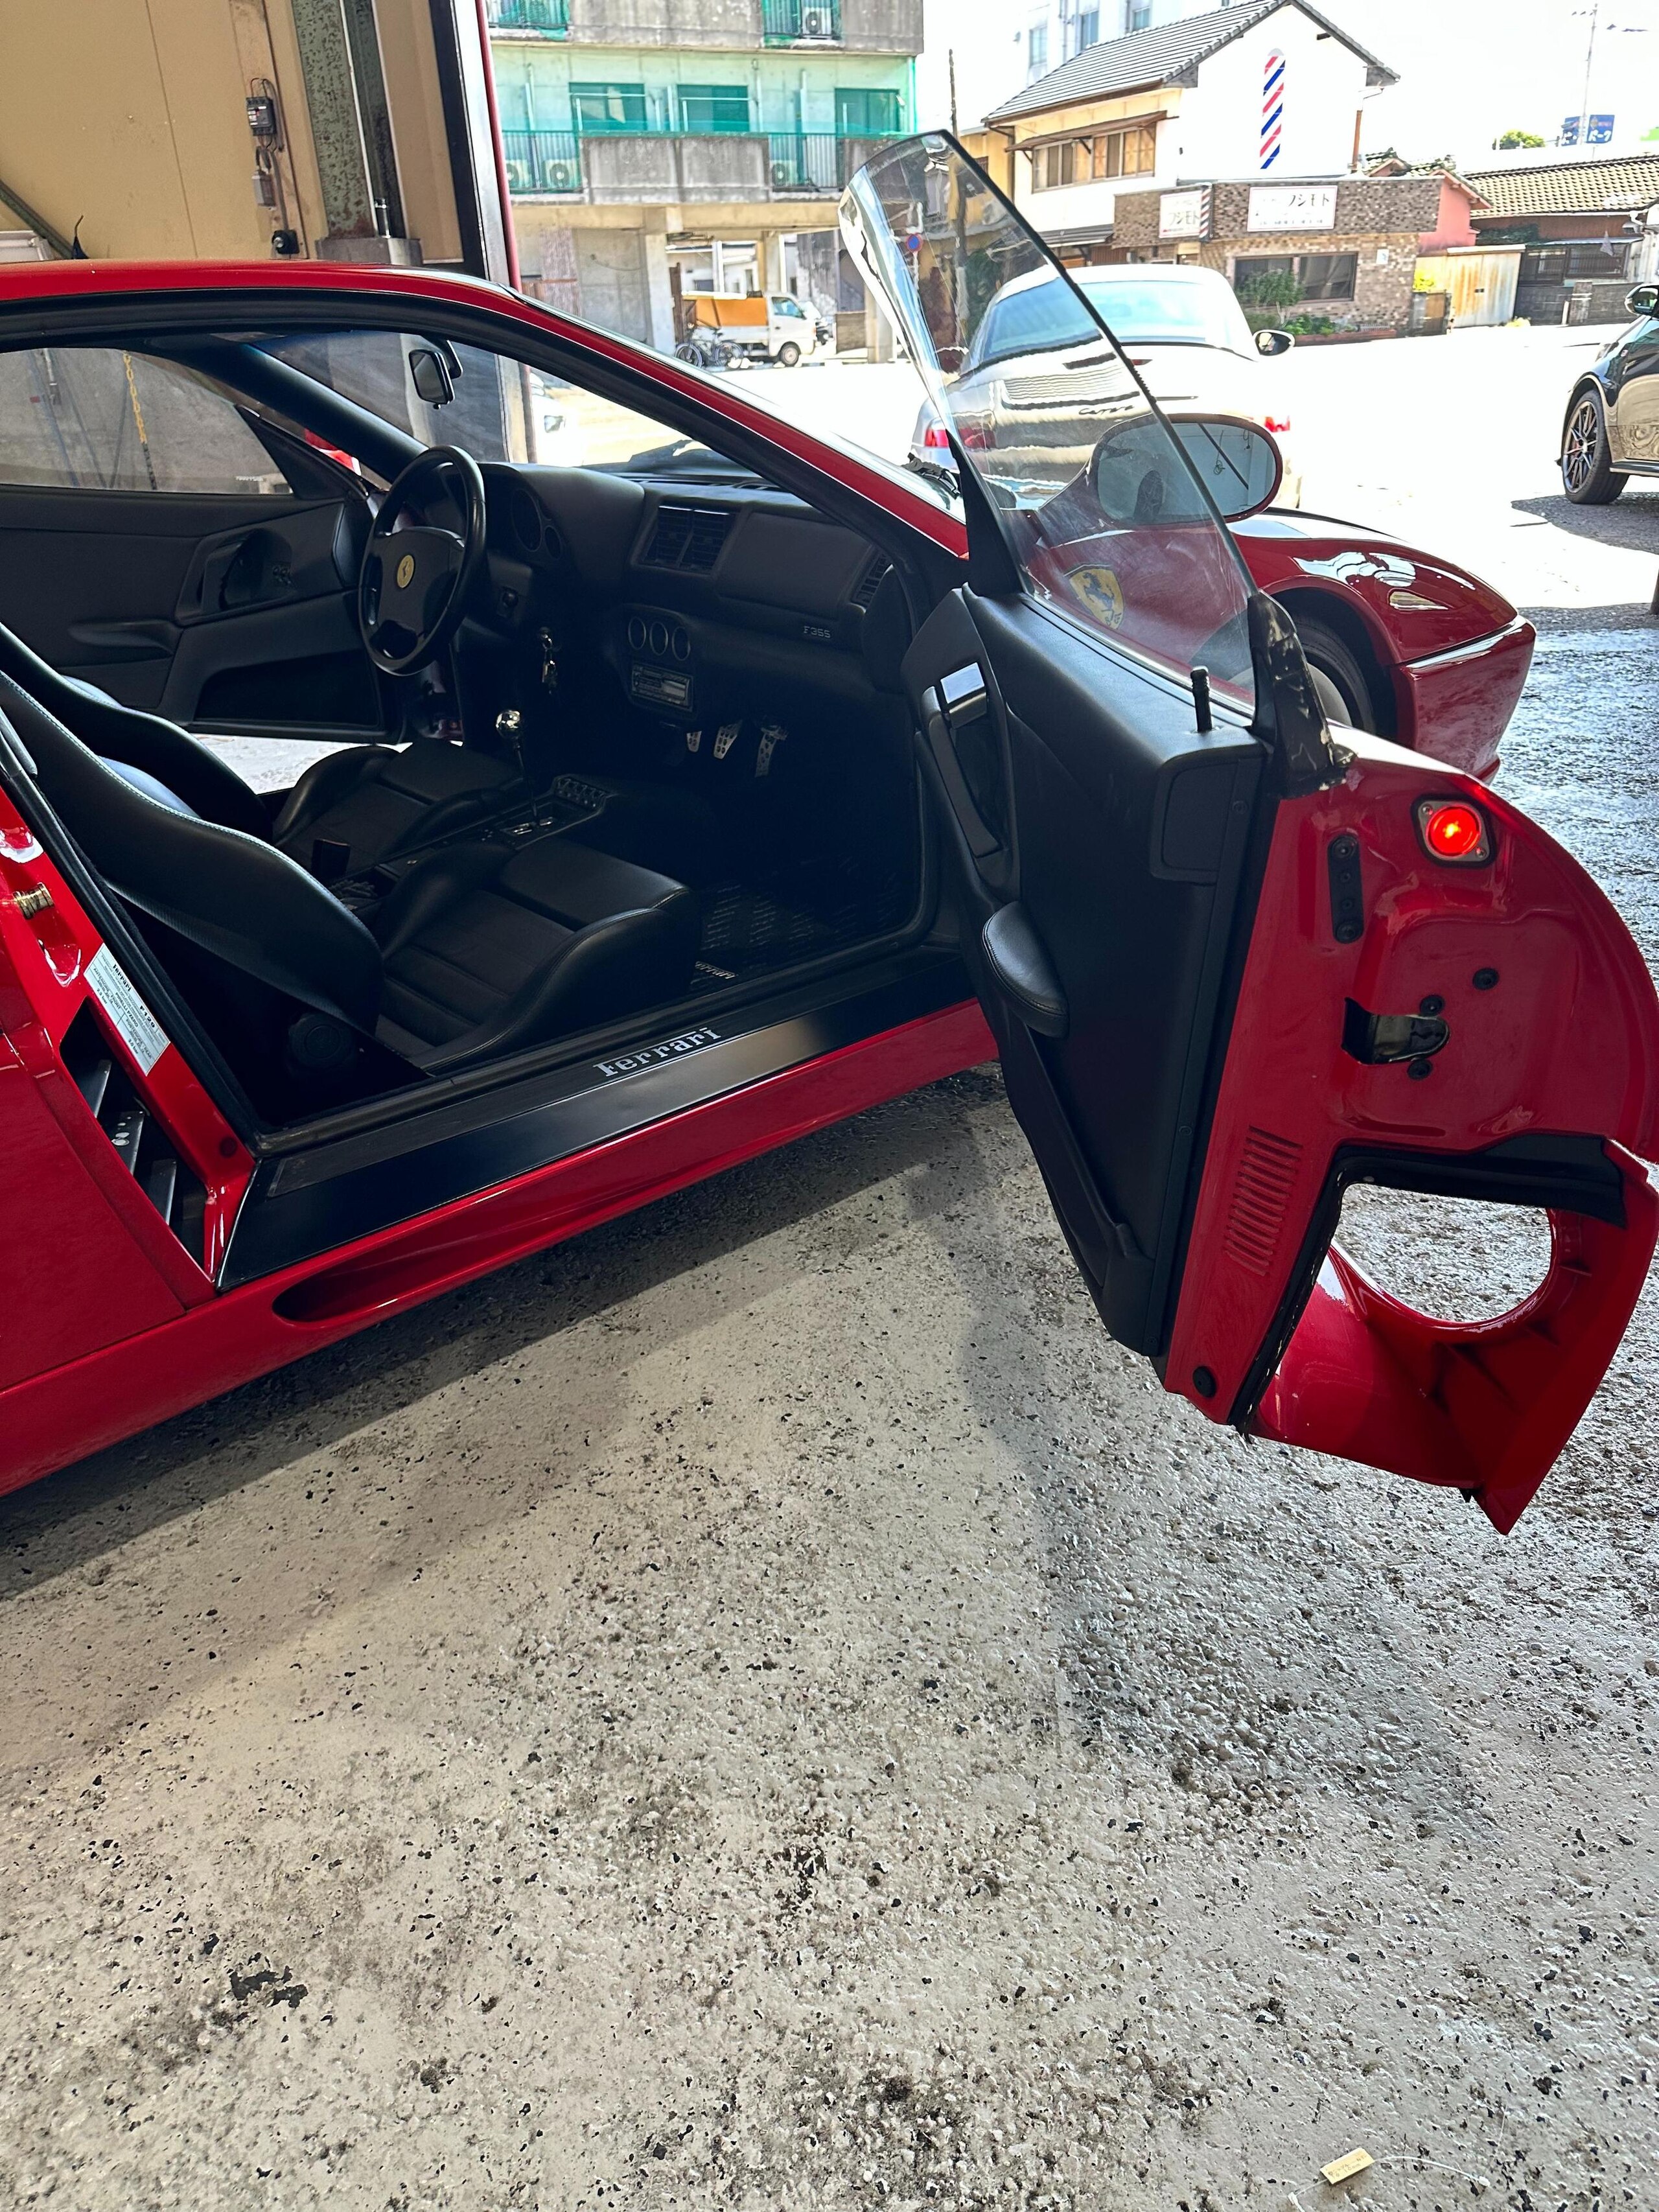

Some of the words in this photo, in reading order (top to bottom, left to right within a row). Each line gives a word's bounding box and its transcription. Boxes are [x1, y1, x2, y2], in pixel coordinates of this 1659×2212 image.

[804, 625, 831, 638] F355
[113, 963, 132, 992] Ferrari
[592, 1027, 722, 1077] Ferrari
